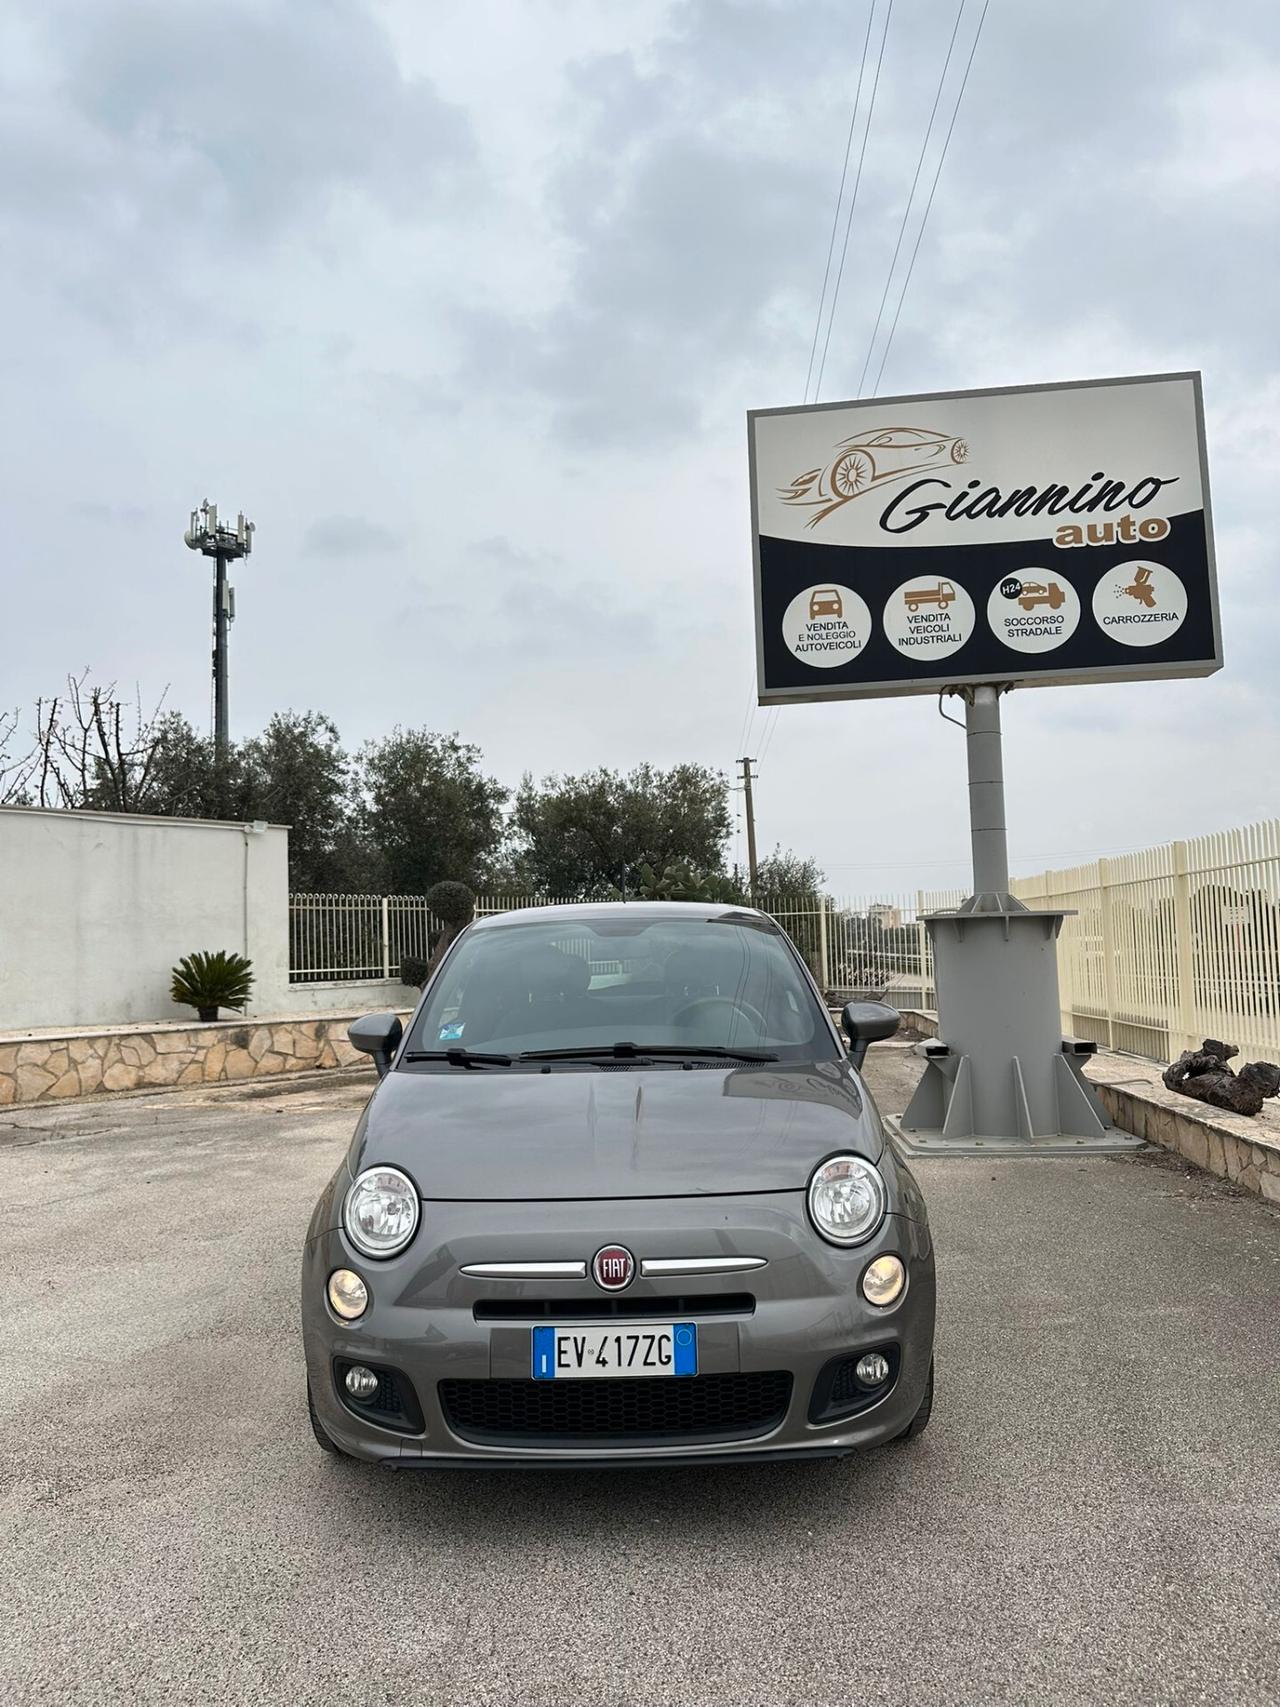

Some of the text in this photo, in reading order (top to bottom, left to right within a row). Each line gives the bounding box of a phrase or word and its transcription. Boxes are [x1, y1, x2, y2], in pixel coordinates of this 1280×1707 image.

[879, 472, 1180, 533] Giannino
[1054, 515, 1169, 546] auto
[1002, 582, 1020, 595] H24
[907, 613, 951, 624] VENDITA
[1004, 615, 1065, 627] SOCCORSO
[1103, 612, 1179, 625] CARROZZERIA
[806, 621, 849, 632] VENDITA
[909, 623, 949, 634] VEICOLI
[1008, 626, 1062, 637] STRADALE
[799, 630, 856, 642] E NOLEGGIO
[899, 633, 962, 646] INDUSTRIALI
[795, 640, 861, 652] AUTOVEICOLI
[603, 1258, 626, 1278] FIAT
